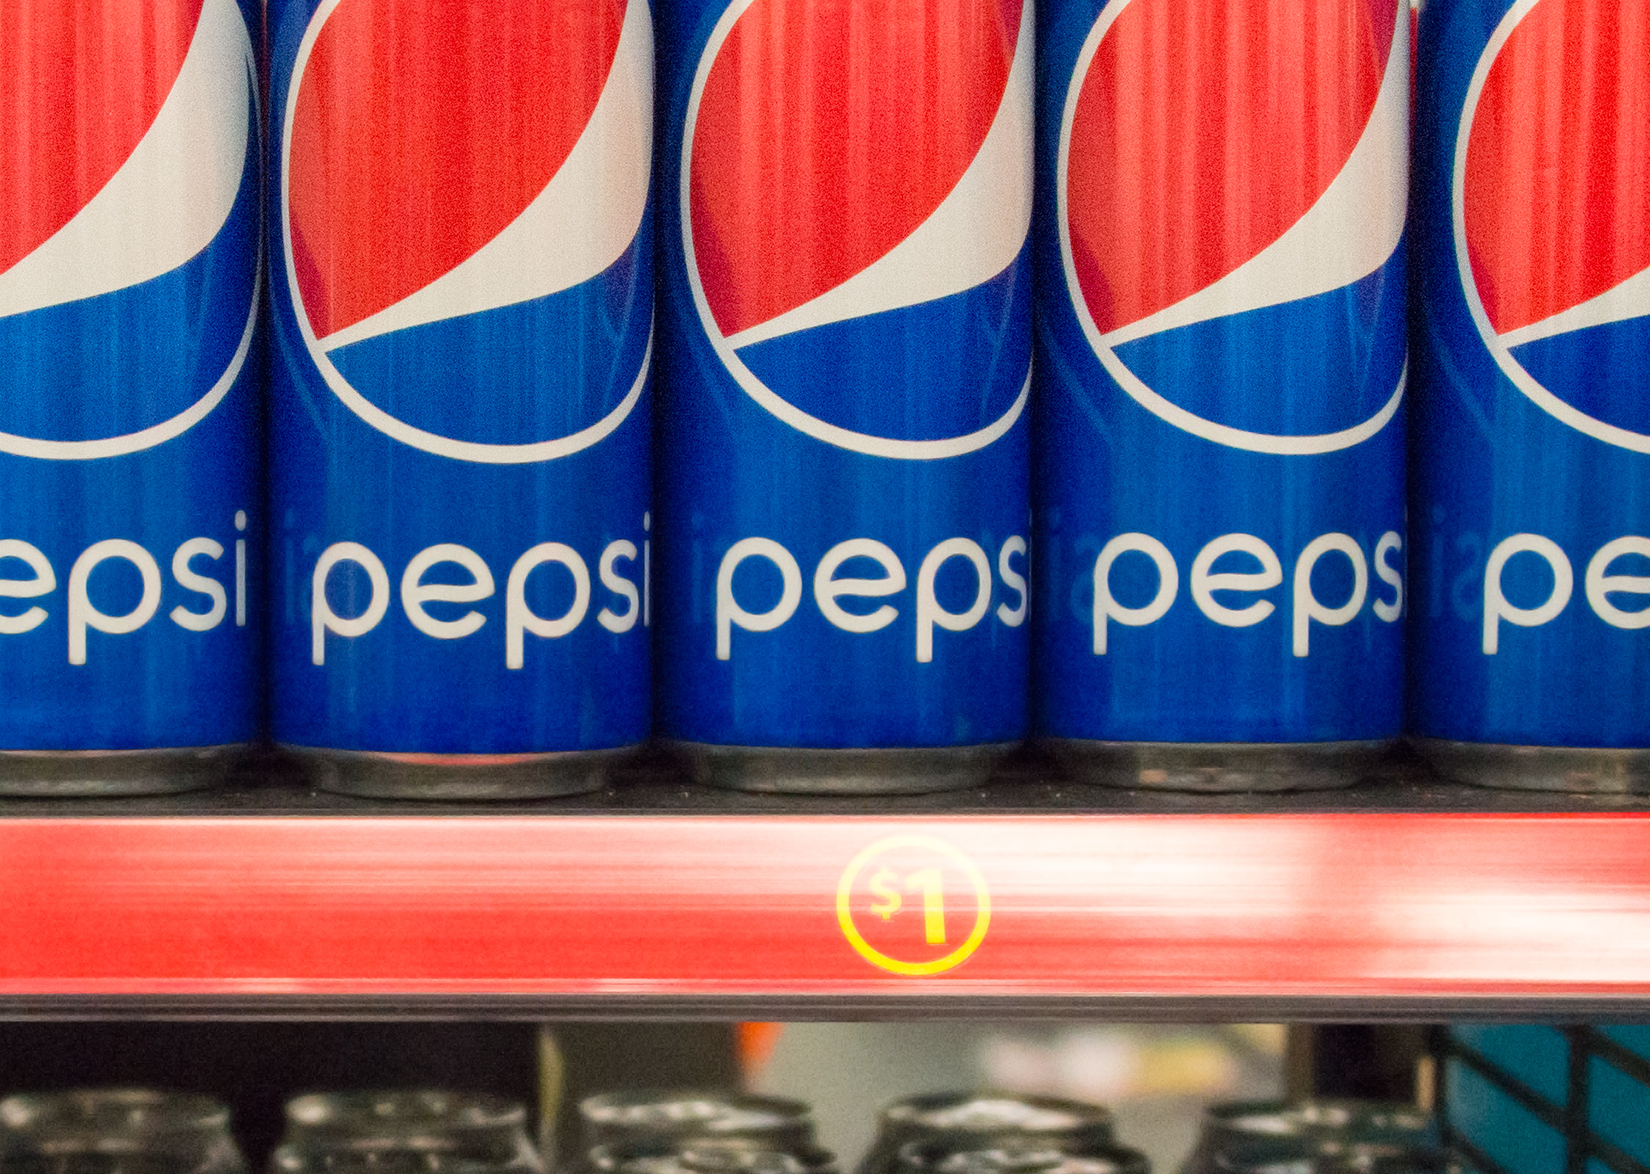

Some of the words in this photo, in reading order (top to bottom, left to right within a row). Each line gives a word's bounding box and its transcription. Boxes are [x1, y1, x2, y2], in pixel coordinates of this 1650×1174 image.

[310, 511, 650, 671] pepsi
[715, 533, 1032, 664] peps
[1092, 530, 1406, 658] peps
[868, 866, 946, 945] $1
